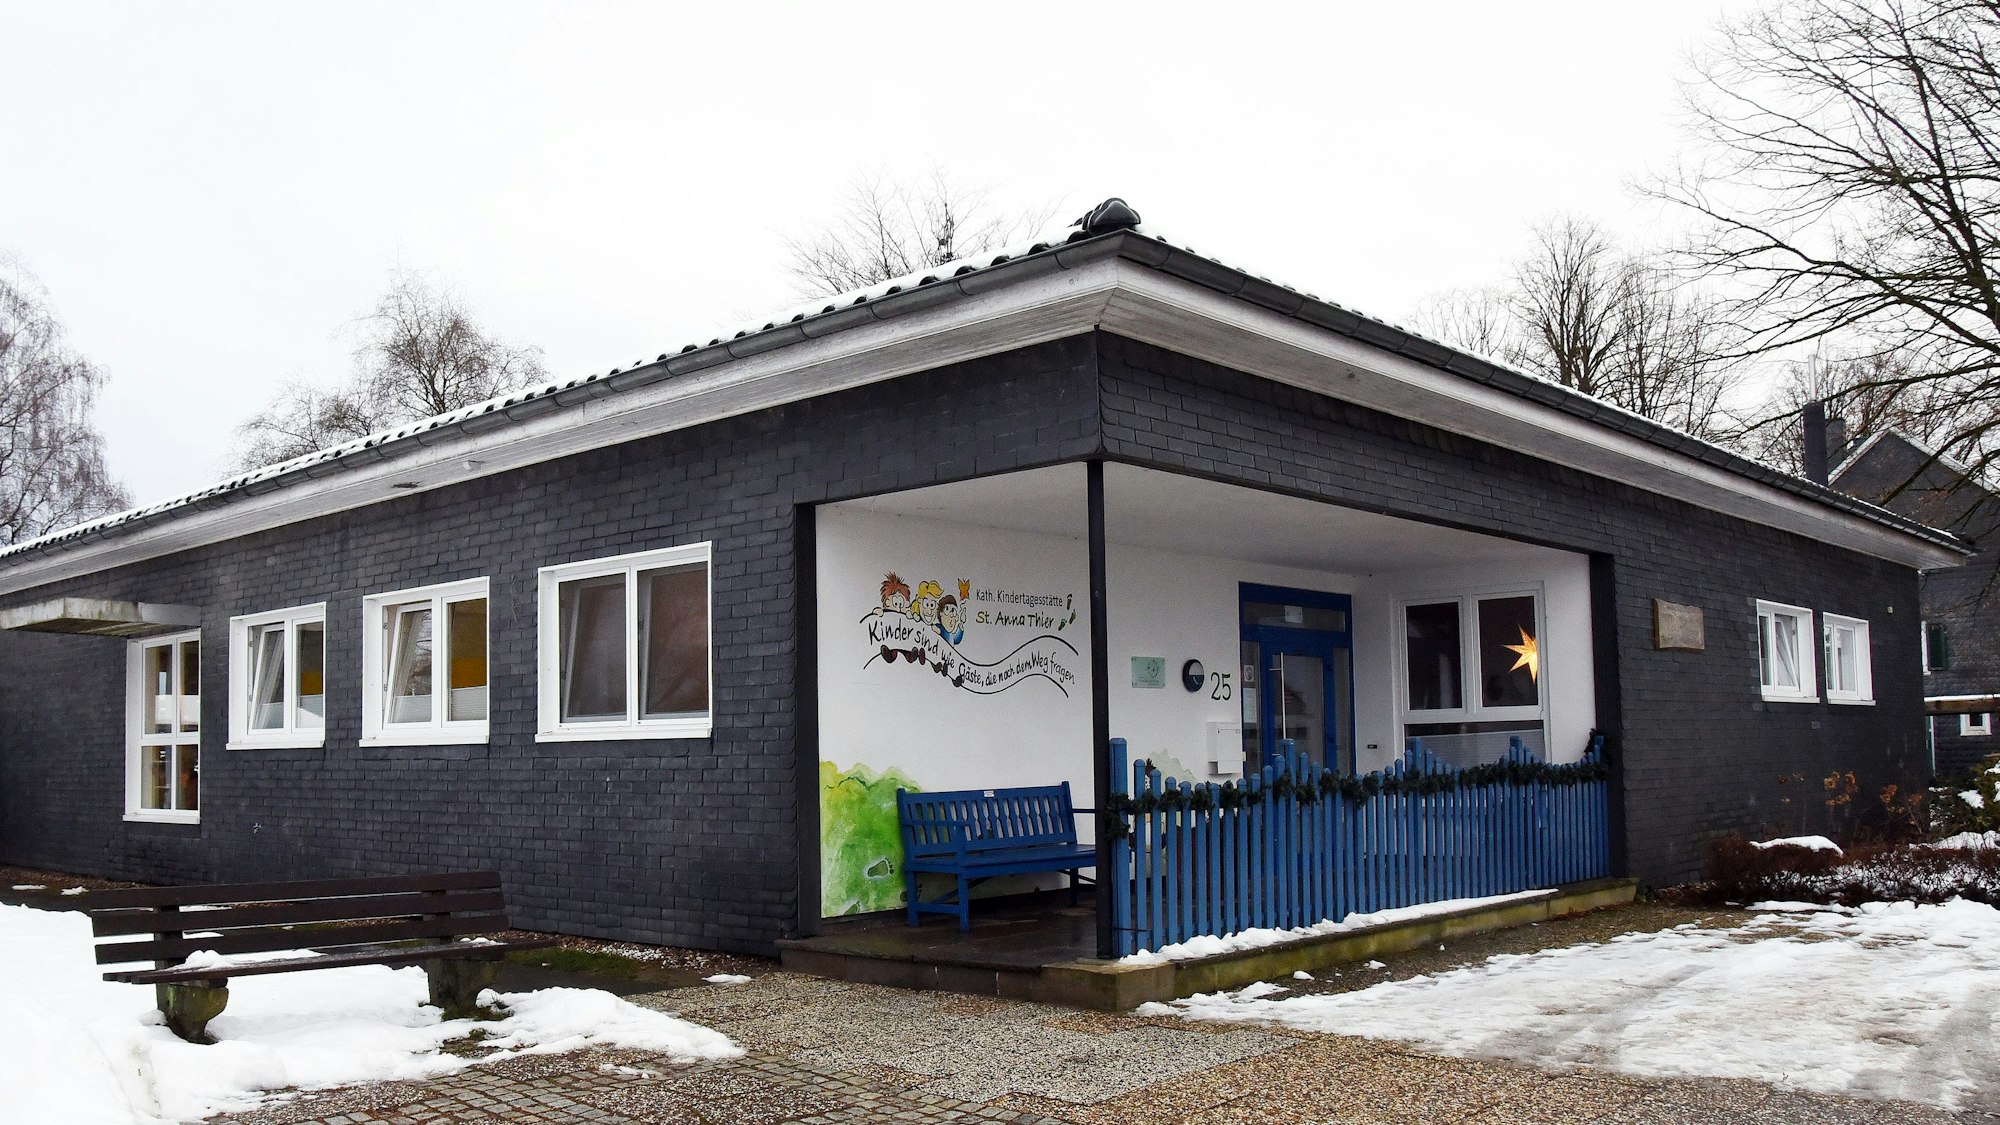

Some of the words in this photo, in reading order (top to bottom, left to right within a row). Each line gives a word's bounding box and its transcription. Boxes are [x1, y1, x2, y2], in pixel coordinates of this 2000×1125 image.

[976, 589, 996, 602] Kath.
[997, 590, 1063, 608] Kindertagesstätte
[975, 610, 993, 624] St.
[995, 611, 1025, 626] Anna
[1027, 611, 1054, 628] Thier
[868, 618, 914, 646] Kinder
[914, 628, 939, 656] sind
[941, 649, 955, 669] wie
[985, 671, 997, 687] die
[998, 664, 1015, 682] nach
[1016, 658, 1032, 674] dem
[1031, 650, 1048, 673] Weg
[1050, 651, 1075, 685] fragen
[1210, 671, 1232, 701] 25
